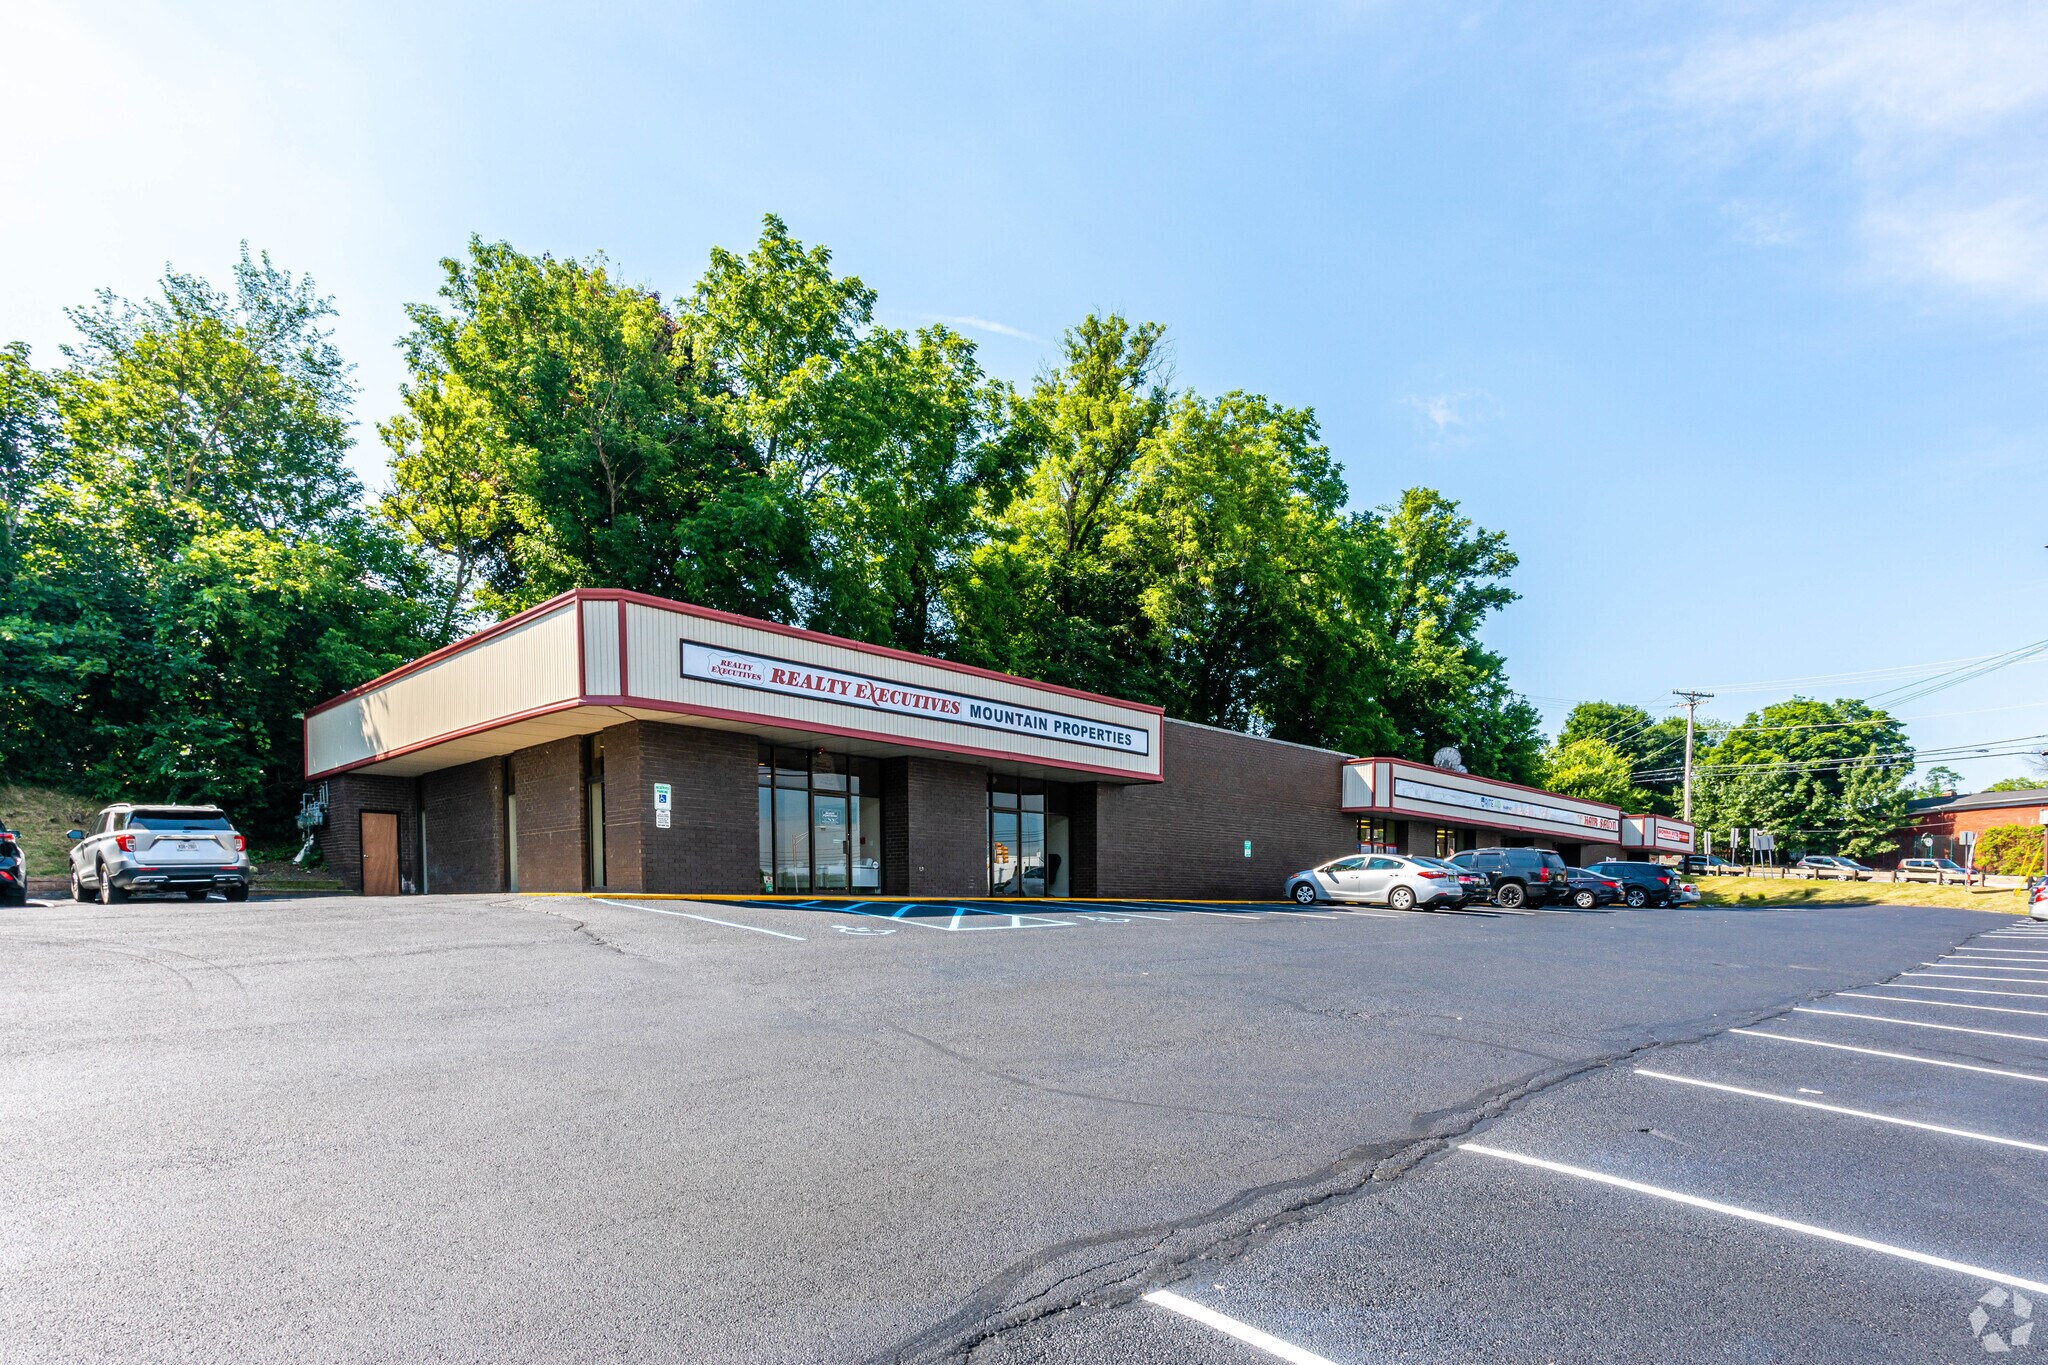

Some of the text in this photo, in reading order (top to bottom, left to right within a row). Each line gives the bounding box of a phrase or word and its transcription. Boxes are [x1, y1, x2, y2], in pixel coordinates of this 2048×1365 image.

[711, 665, 762, 681] EXECUTIVES
[720, 659, 753, 671] REALTY
[769, 667, 961, 715] REALTY EXECUTIVES
[970, 704, 1132, 746] MOUNTAIN PROPERTIES
